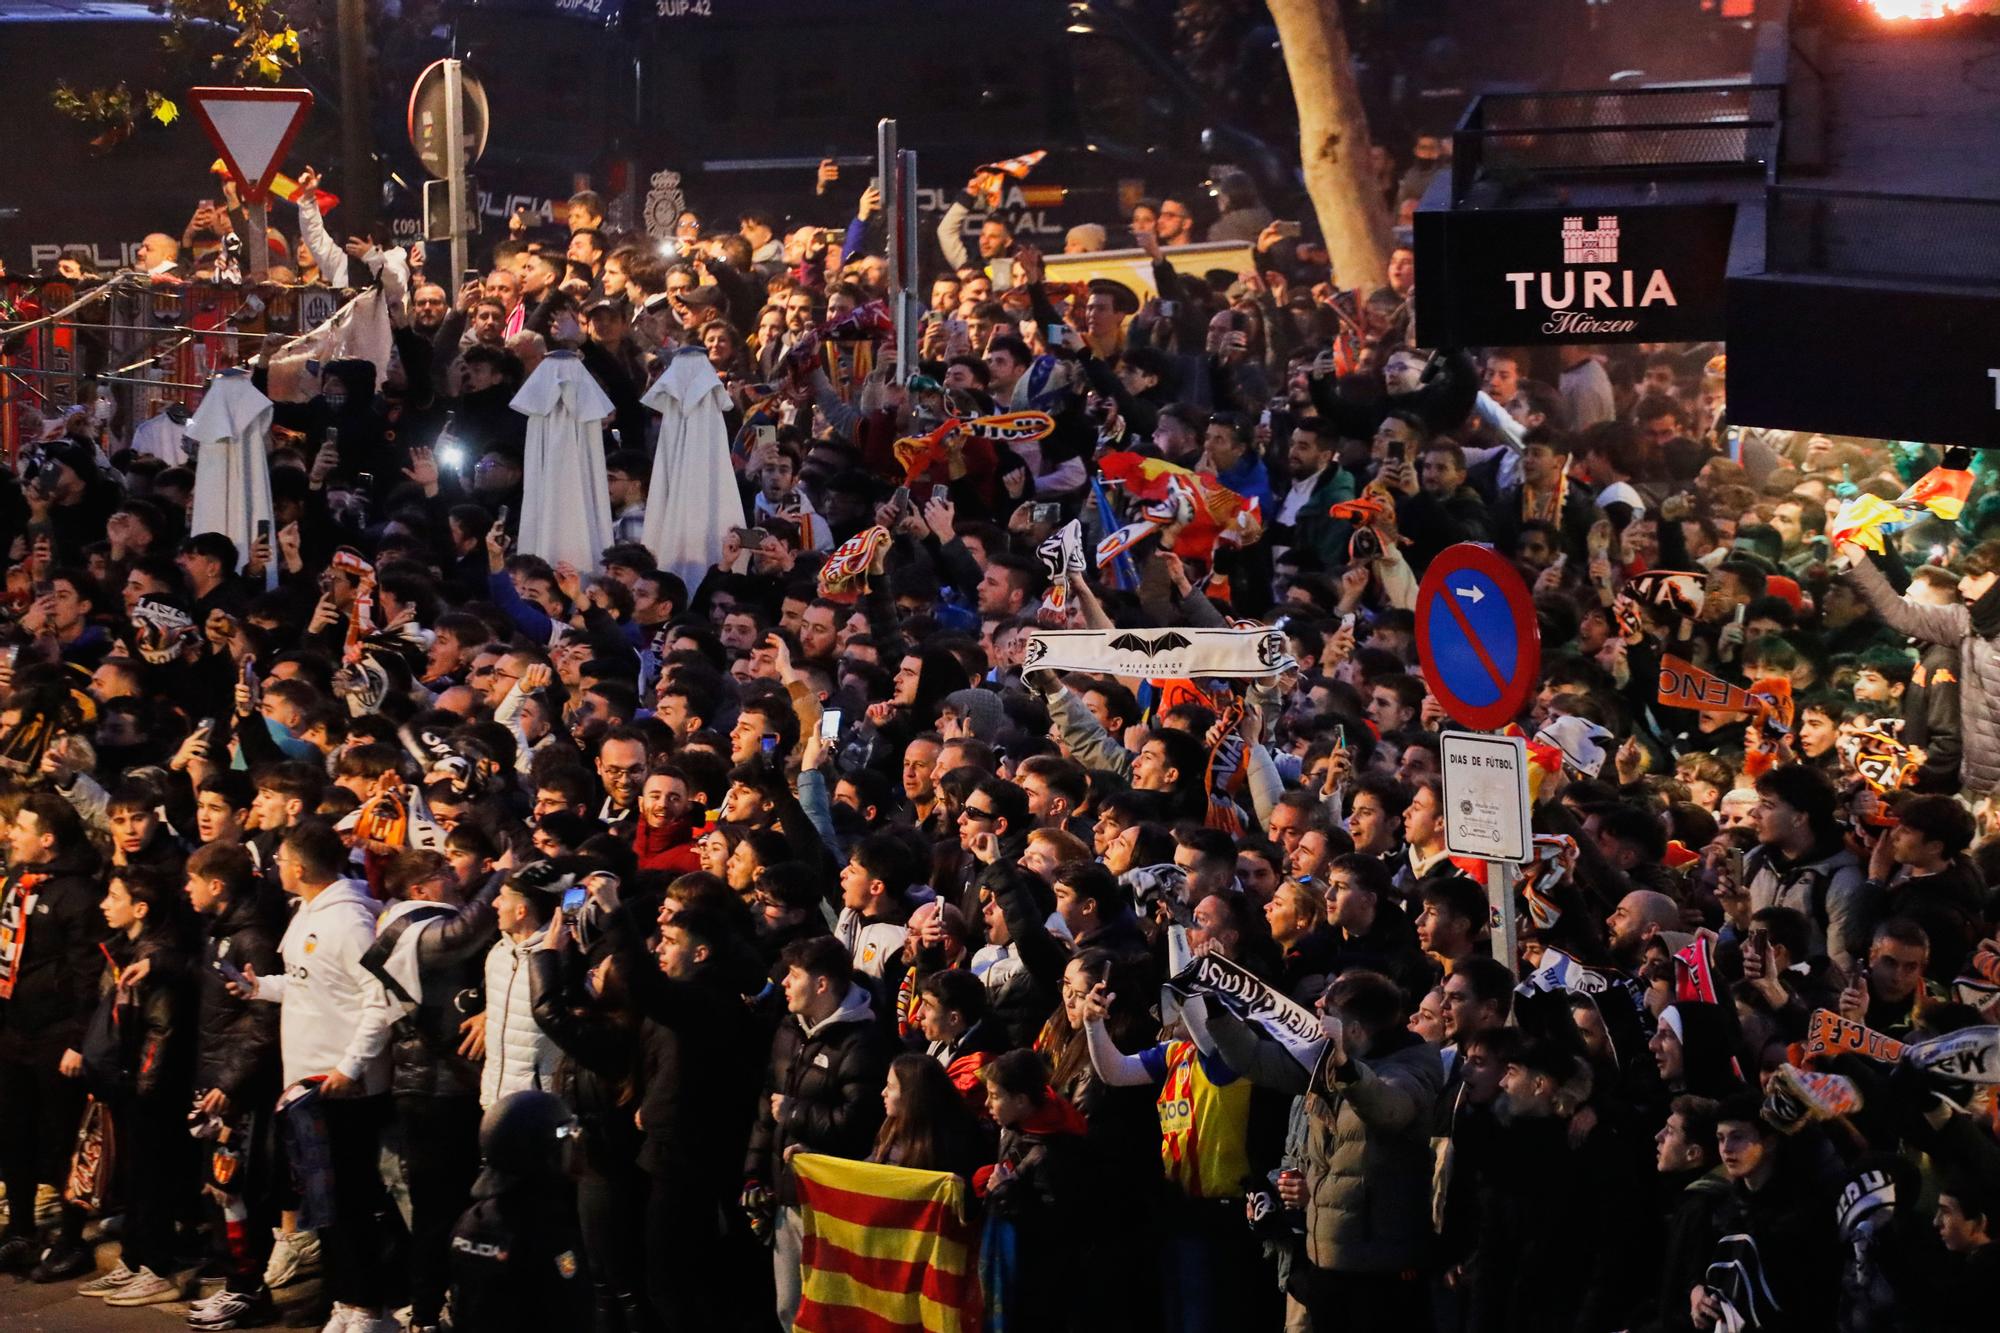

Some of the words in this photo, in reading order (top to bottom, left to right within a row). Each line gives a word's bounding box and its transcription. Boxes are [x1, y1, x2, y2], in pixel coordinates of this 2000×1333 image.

[1505, 268, 1679, 310] TURIA
[1541, 310, 1638, 335] Märzen
[1472, 756, 1481, 766] DE
[1485, 755, 1513, 770] FÚTBOL
